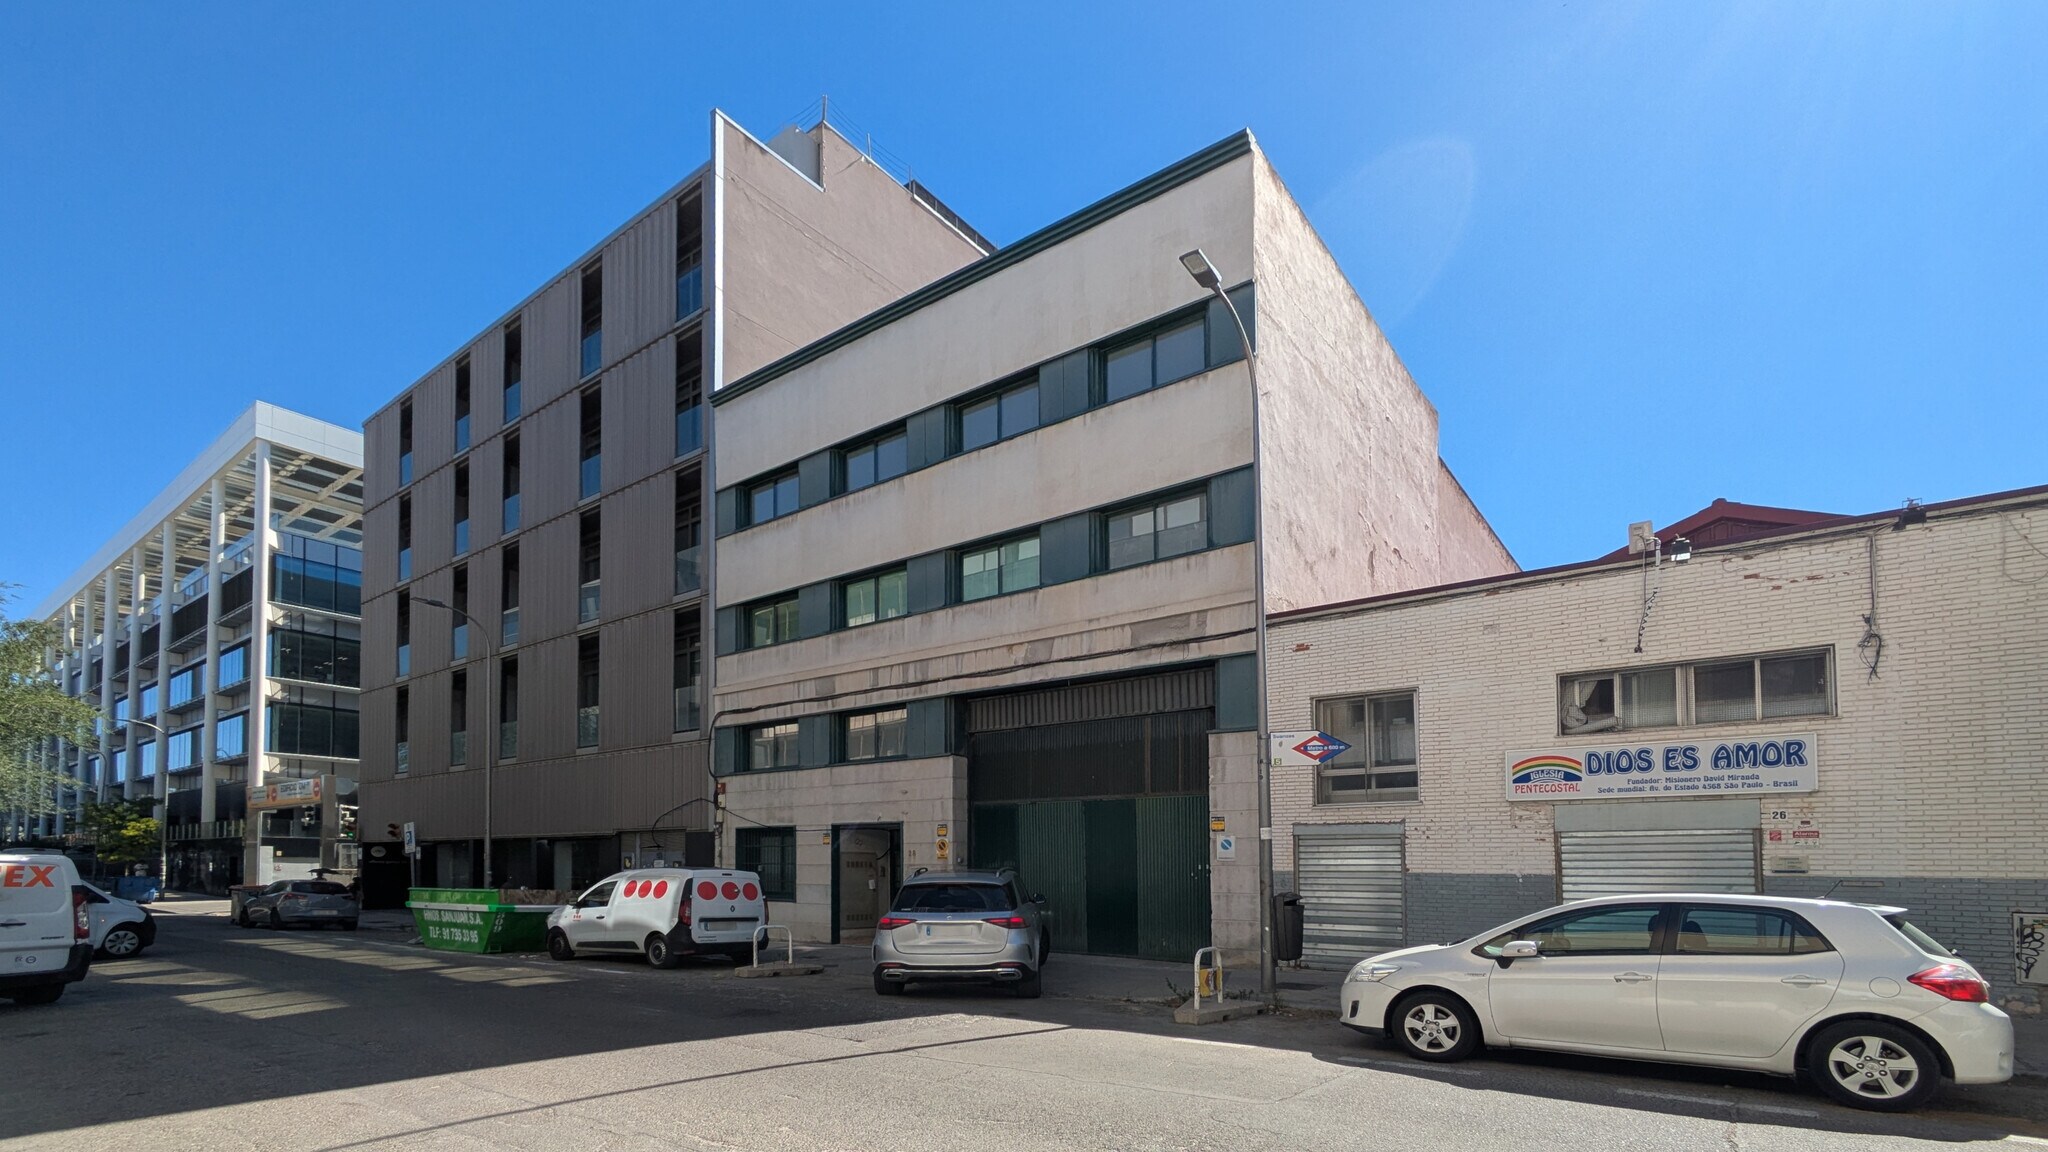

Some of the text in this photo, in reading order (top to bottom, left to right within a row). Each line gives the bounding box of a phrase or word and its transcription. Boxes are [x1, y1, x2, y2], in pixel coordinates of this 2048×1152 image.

[1585, 739, 1808, 776] DIOS ES AMOR
[1530, 769, 1565, 781] IGLESIA
[1627, 777, 1663, 785] Fundador:
[1727, 773, 1760, 781] Miranda
[1514, 783, 1580, 794] PENTECOSTAL
[1617, 785, 1647, 793] mundial:
[1674, 783, 1699, 791] Estado
[1702, 782, 1721, 790] 4568
[1724, 781, 1739, 789] São
[1773, 779, 1798, 787] Brasil
[1772, 811, 1787, 820] 26
[0, 865, 56, 888] EX
